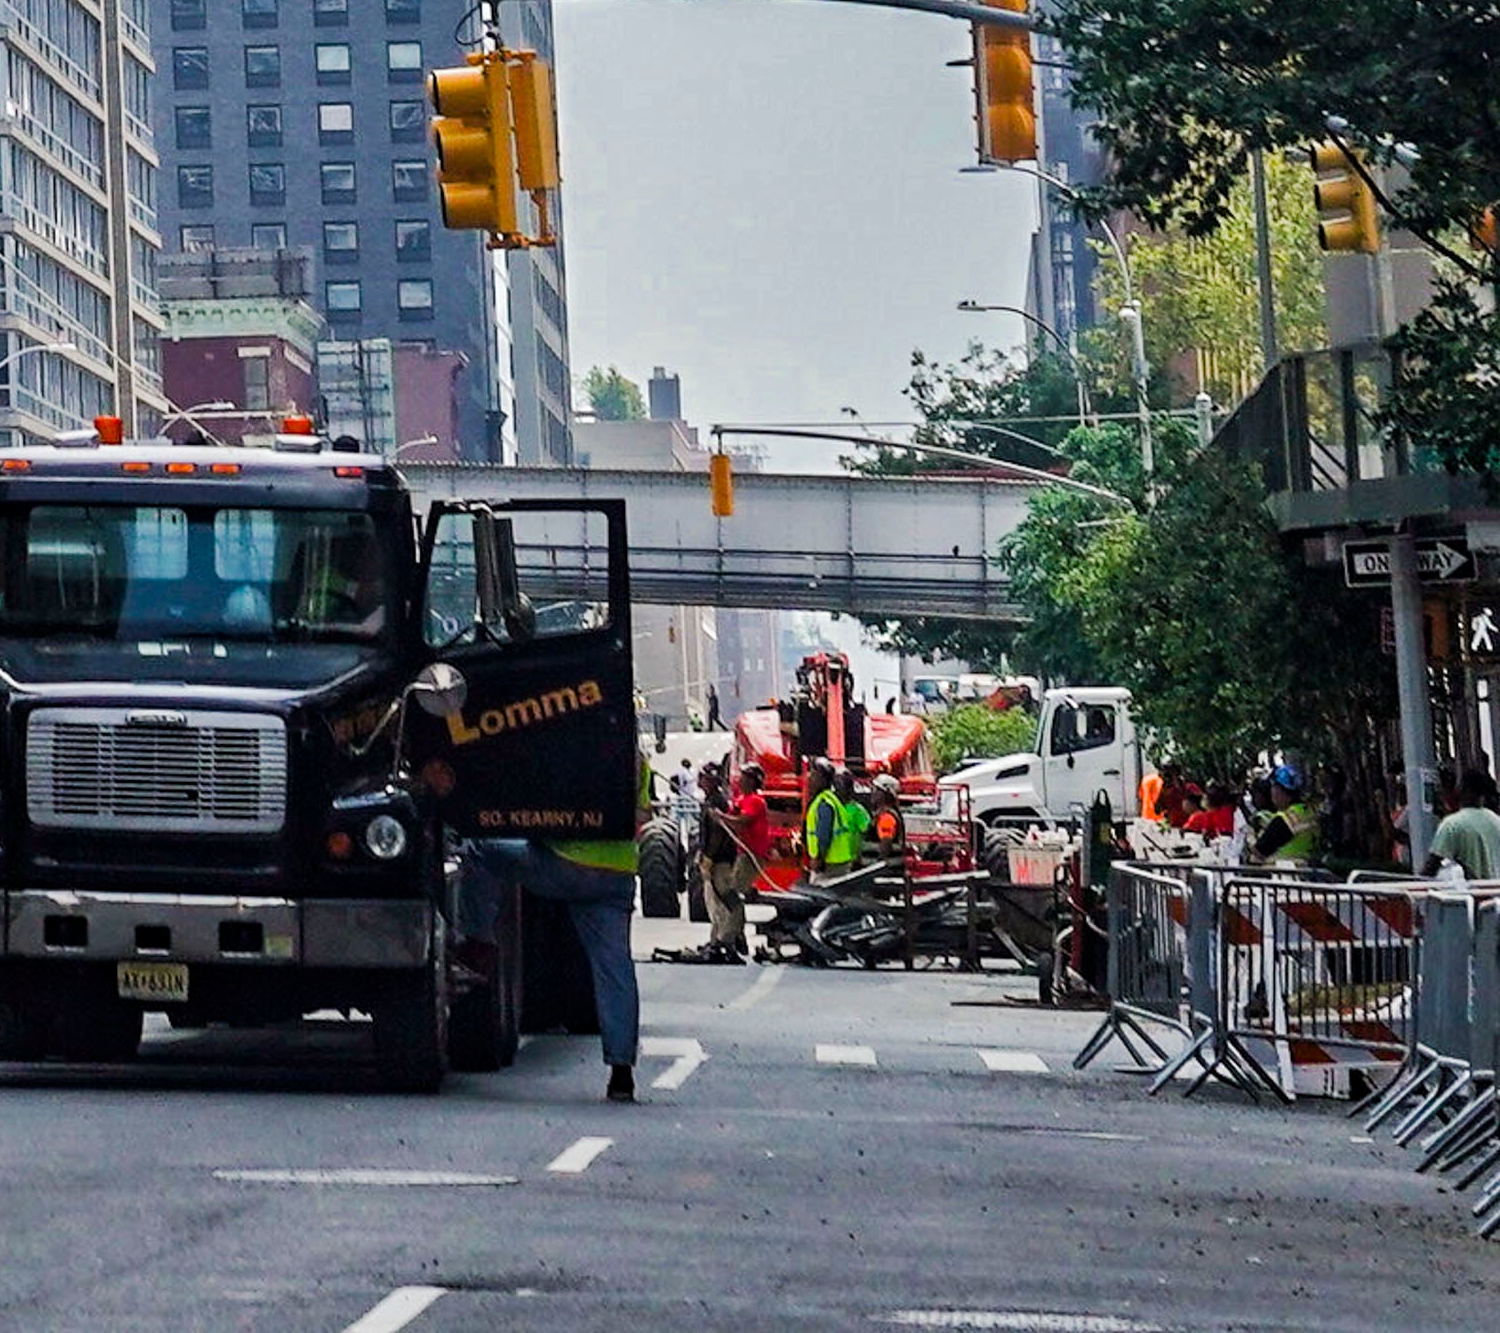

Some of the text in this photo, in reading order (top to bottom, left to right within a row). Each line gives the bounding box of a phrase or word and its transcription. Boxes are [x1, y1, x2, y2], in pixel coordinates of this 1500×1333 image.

[1364, 555, 1390, 573] ON
[446, 680, 602, 746] Lomma
[583, 811, 603, 827] NJ
